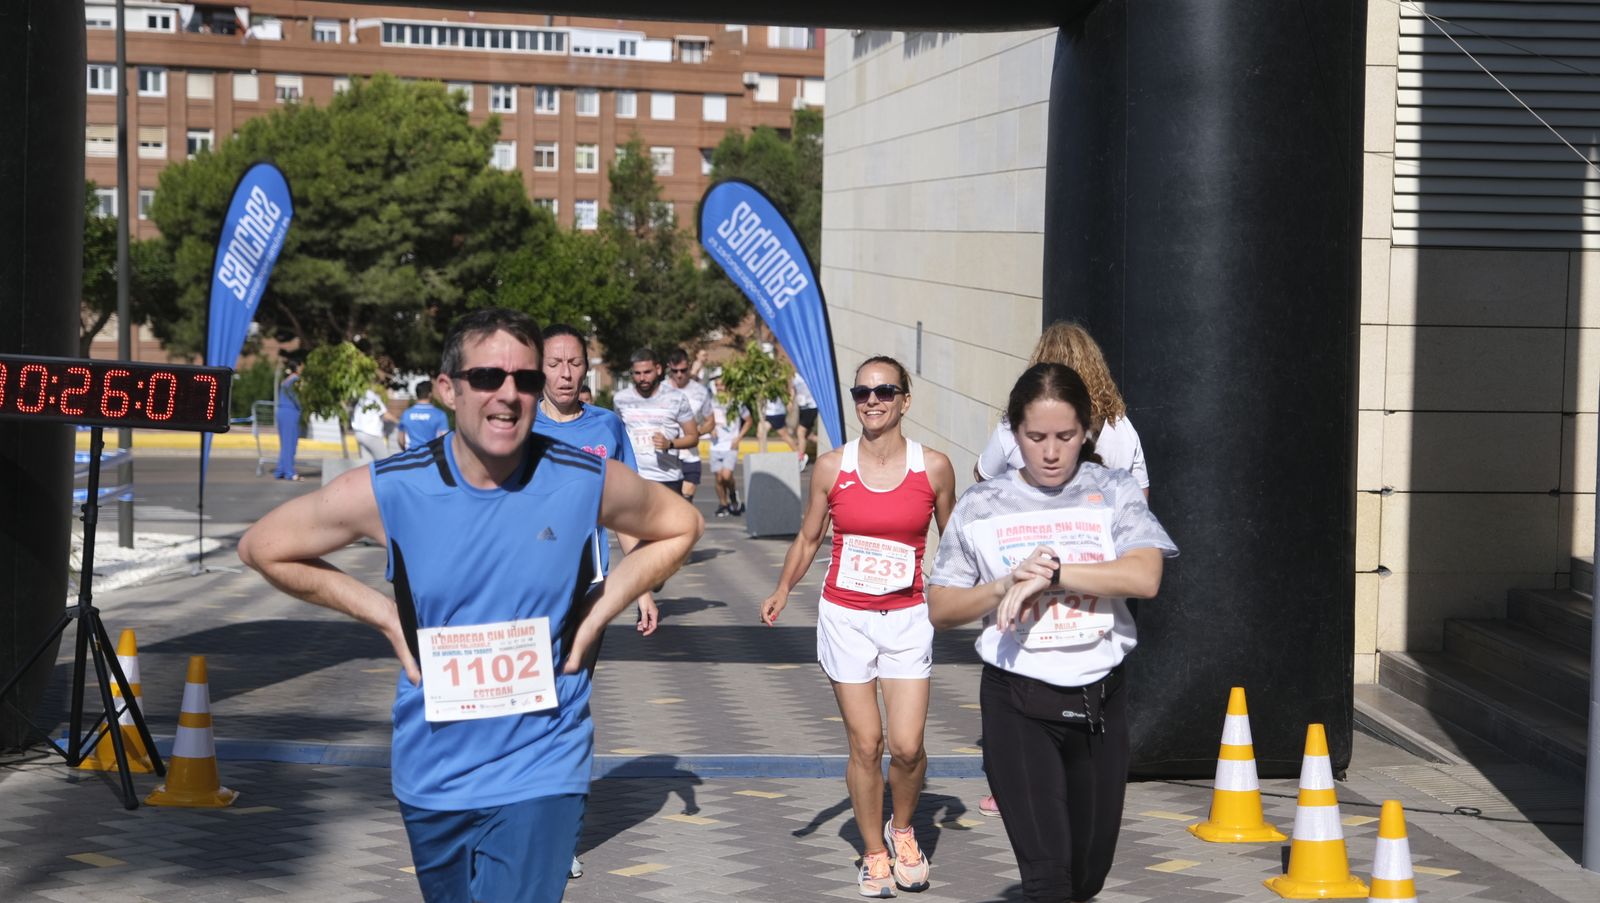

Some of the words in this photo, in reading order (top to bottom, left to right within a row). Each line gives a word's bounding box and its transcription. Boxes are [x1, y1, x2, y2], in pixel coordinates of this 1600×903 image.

[1006, 524, 1052, 538] CARRERA
[1055, 521, 1073, 534] SIN
[1075, 521, 1102, 535] HUMO
[851, 554, 907, 579] 1233
[440, 631, 484, 645] CARRERA
[487, 629, 505, 642] SIN
[507, 625, 535, 640] HUMO
[442, 649, 540, 688] 1102
[474, 686, 513, 699] ESTEBAN
